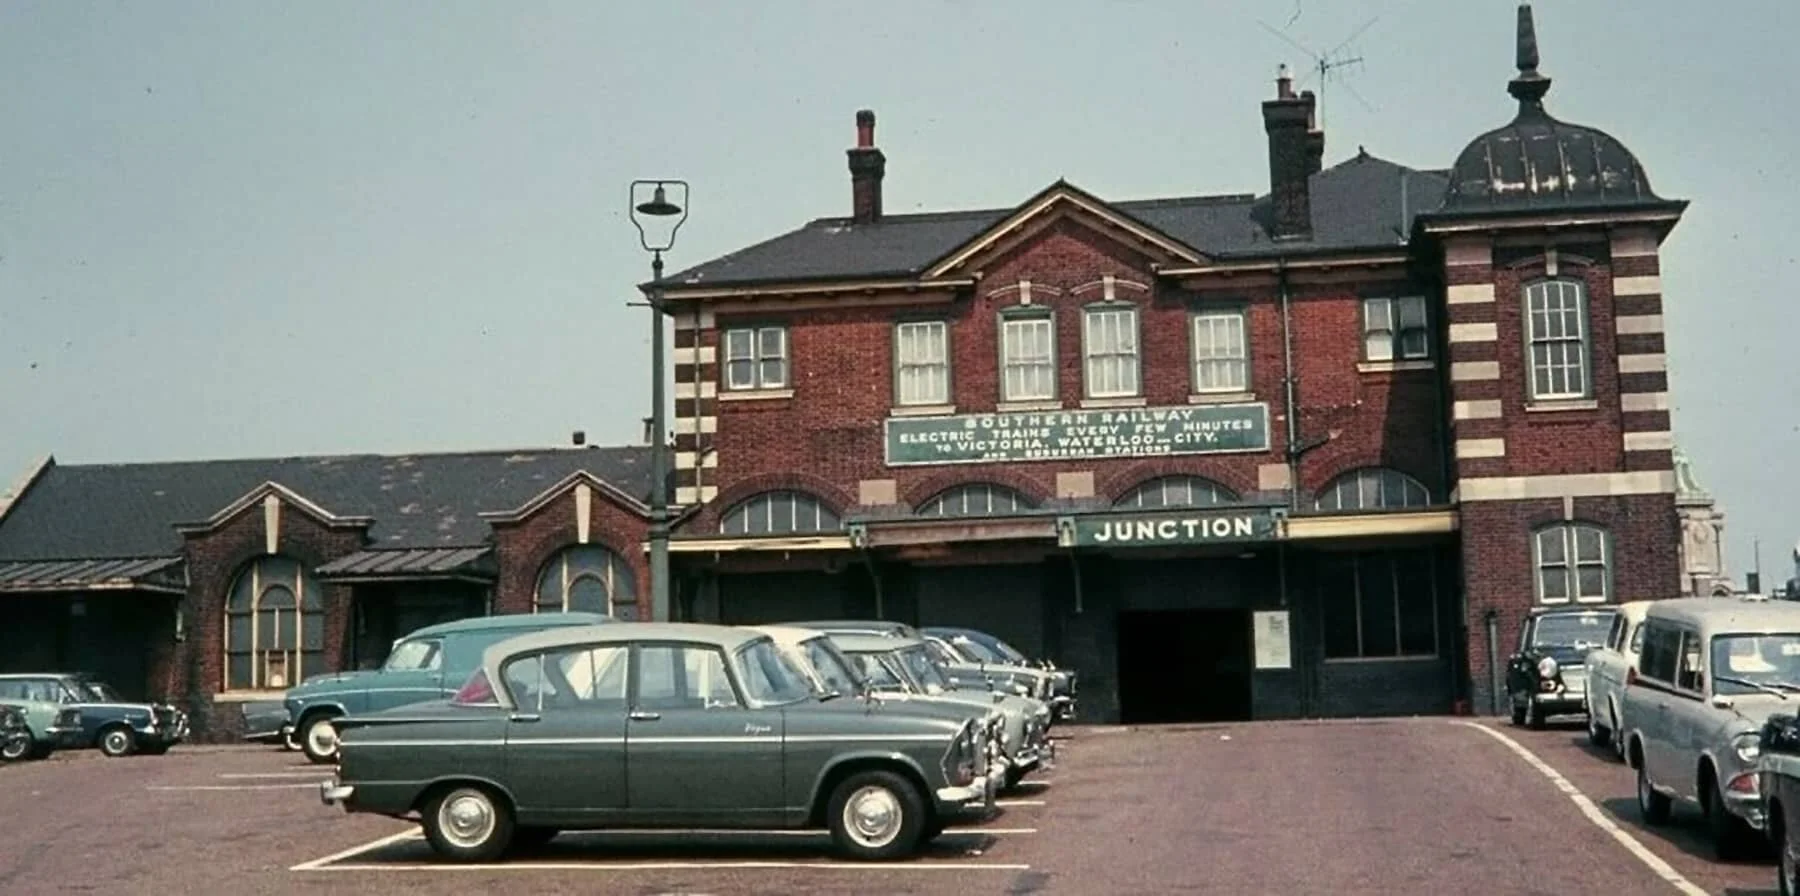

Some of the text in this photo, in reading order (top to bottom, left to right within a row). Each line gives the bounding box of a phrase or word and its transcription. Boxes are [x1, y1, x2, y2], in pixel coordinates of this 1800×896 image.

[965, 409, 1193, 429] SOUTHERN RAILWAY
[899, 419, 1253, 443] ELECTRIC TRAINS EVERY FEW MINUTES
[936, 444, 952, 453] TO
[1058, 434, 1154, 447] WATERLOO
[1025, 448, 1095, 458] SUBURBAN
[1105, 445, 1171, 454] STATIONS
[1094, 517, 1253, 541] JUNCTION
